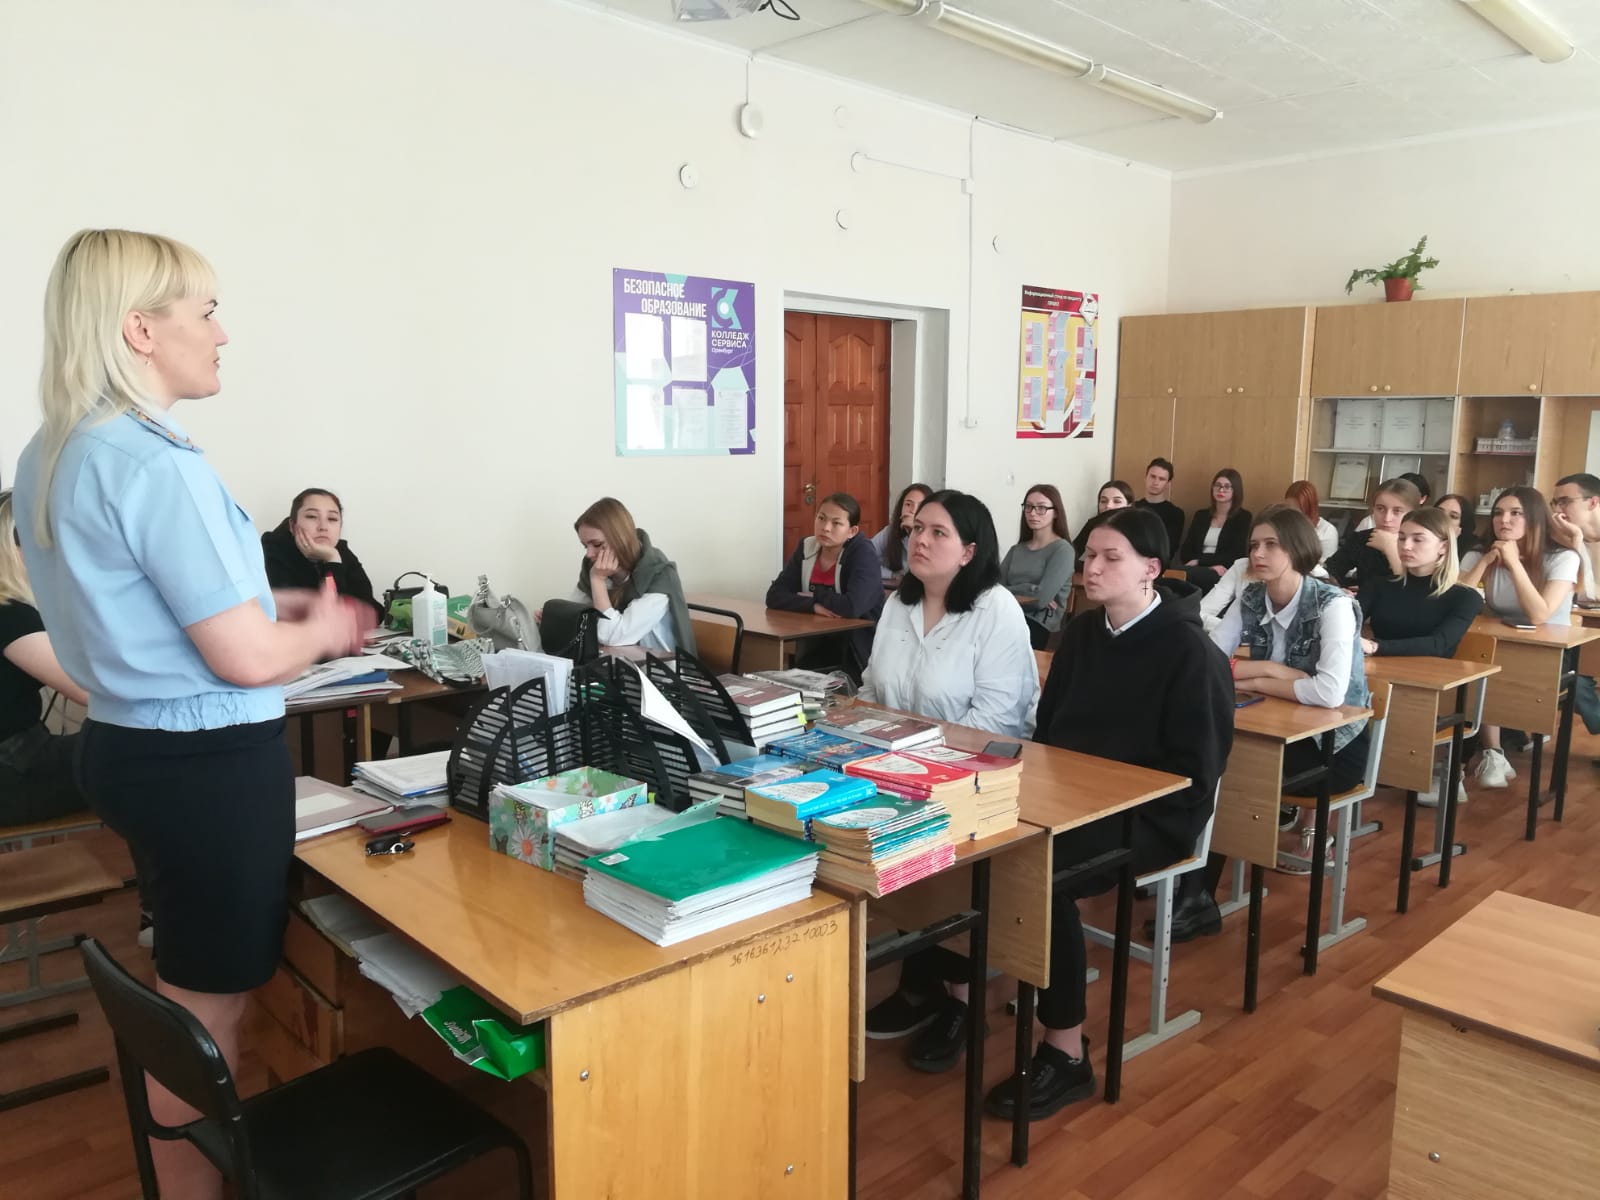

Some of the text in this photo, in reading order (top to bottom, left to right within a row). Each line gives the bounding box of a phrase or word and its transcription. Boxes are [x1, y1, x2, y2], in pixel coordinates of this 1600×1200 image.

[624, 278, 685, 298] БЕЗОПАСНОЕ
[641, 298, 707, 318] ОБРАЗОВАНИЕ
[711, 330, 749, 341] КОЛЛЕДЖ
[711, 339, 747, 348] СЕРВИСА
